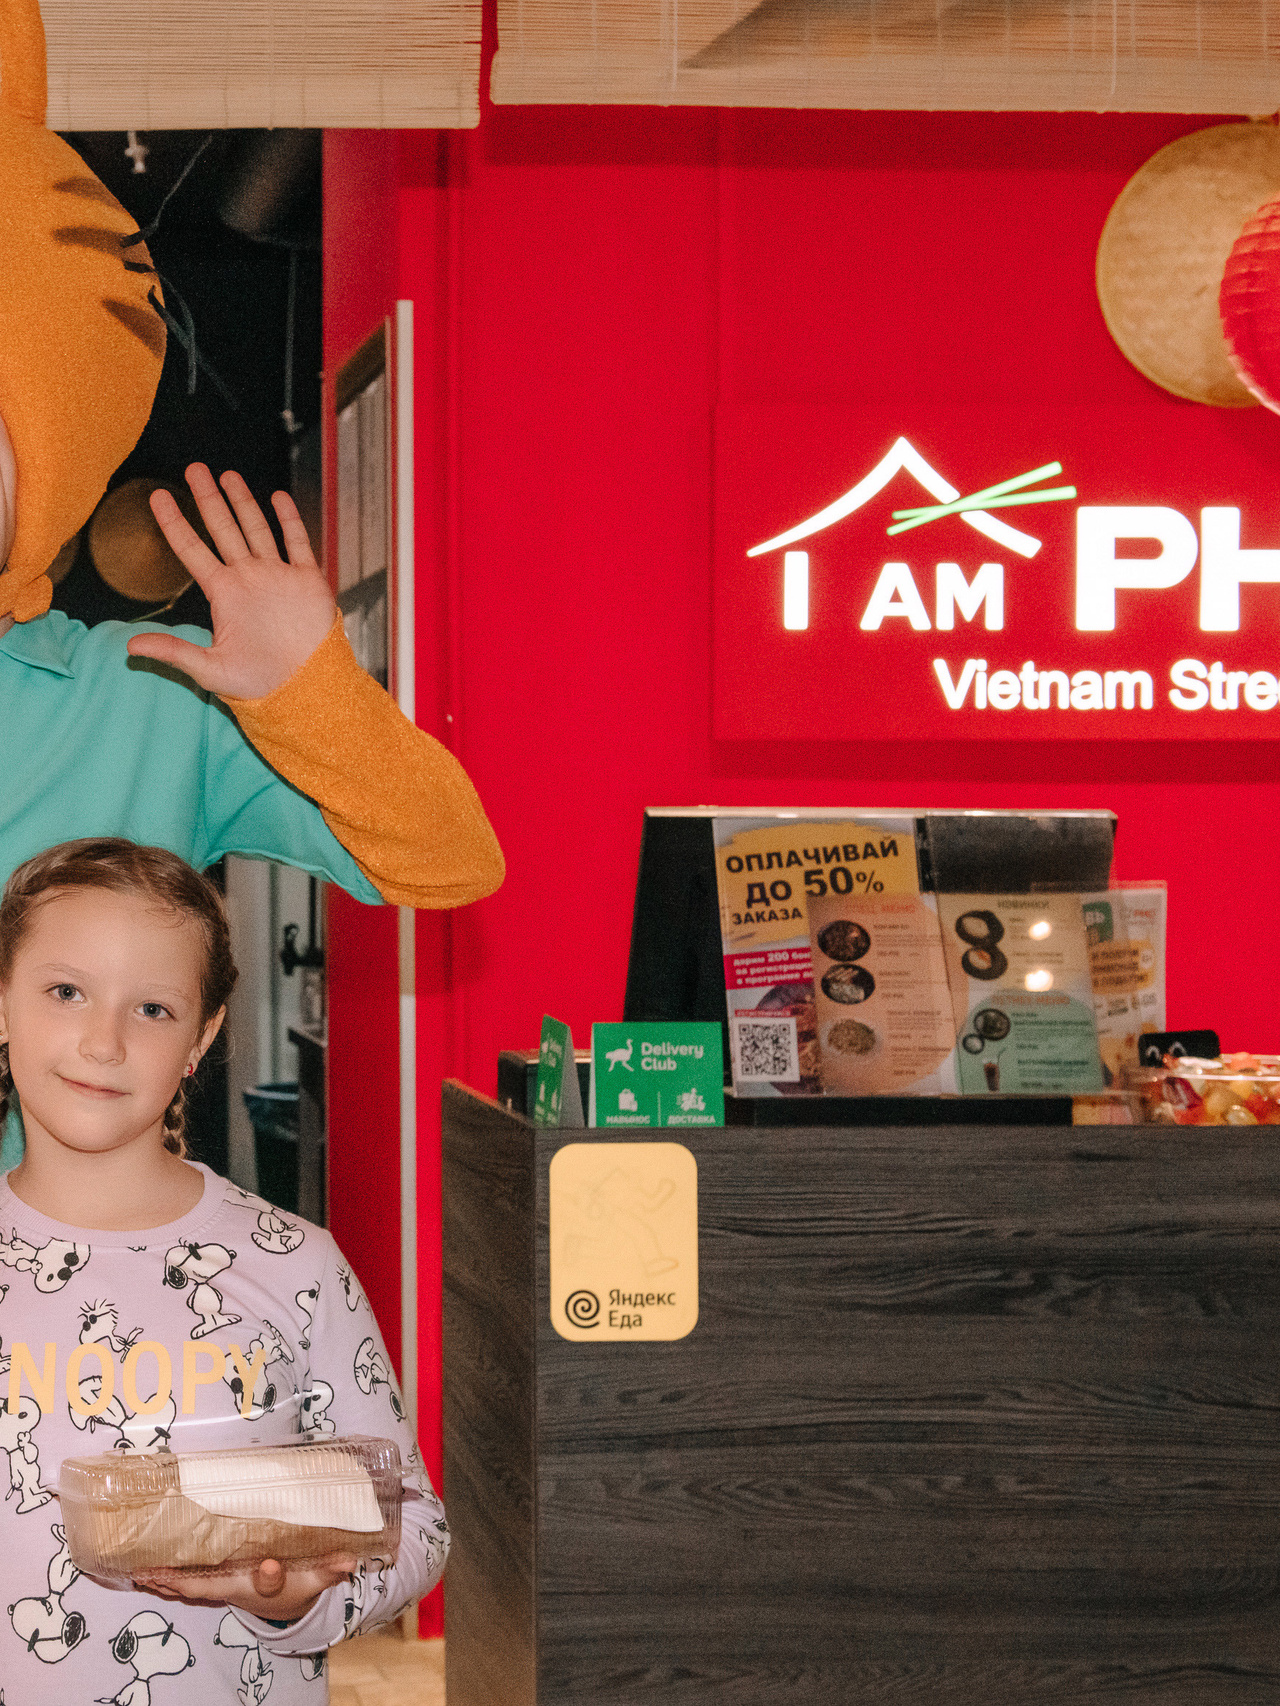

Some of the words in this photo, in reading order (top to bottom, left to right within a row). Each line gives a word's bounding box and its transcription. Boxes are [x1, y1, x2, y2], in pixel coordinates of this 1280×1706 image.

[859, 562, 1004, 631] AM
[932, 657, 1154, 711] Vietnam
[1168, 657, 1280, 711] Stre
[725, 835, 899, 873] ОПЛАЧИВАЙ
[746, 879, 793, 909] ДО
[804, 866, 885, 898] 50%
[731, 907, 804, 926] ЗАКАЗА
[641, 1041, 704, 1059] Delivery
[641, 1057, 677, 1072] Club
[608, 1289, 677, 1308] Яндекс
[608, 1310, 643, 1329] Еда
